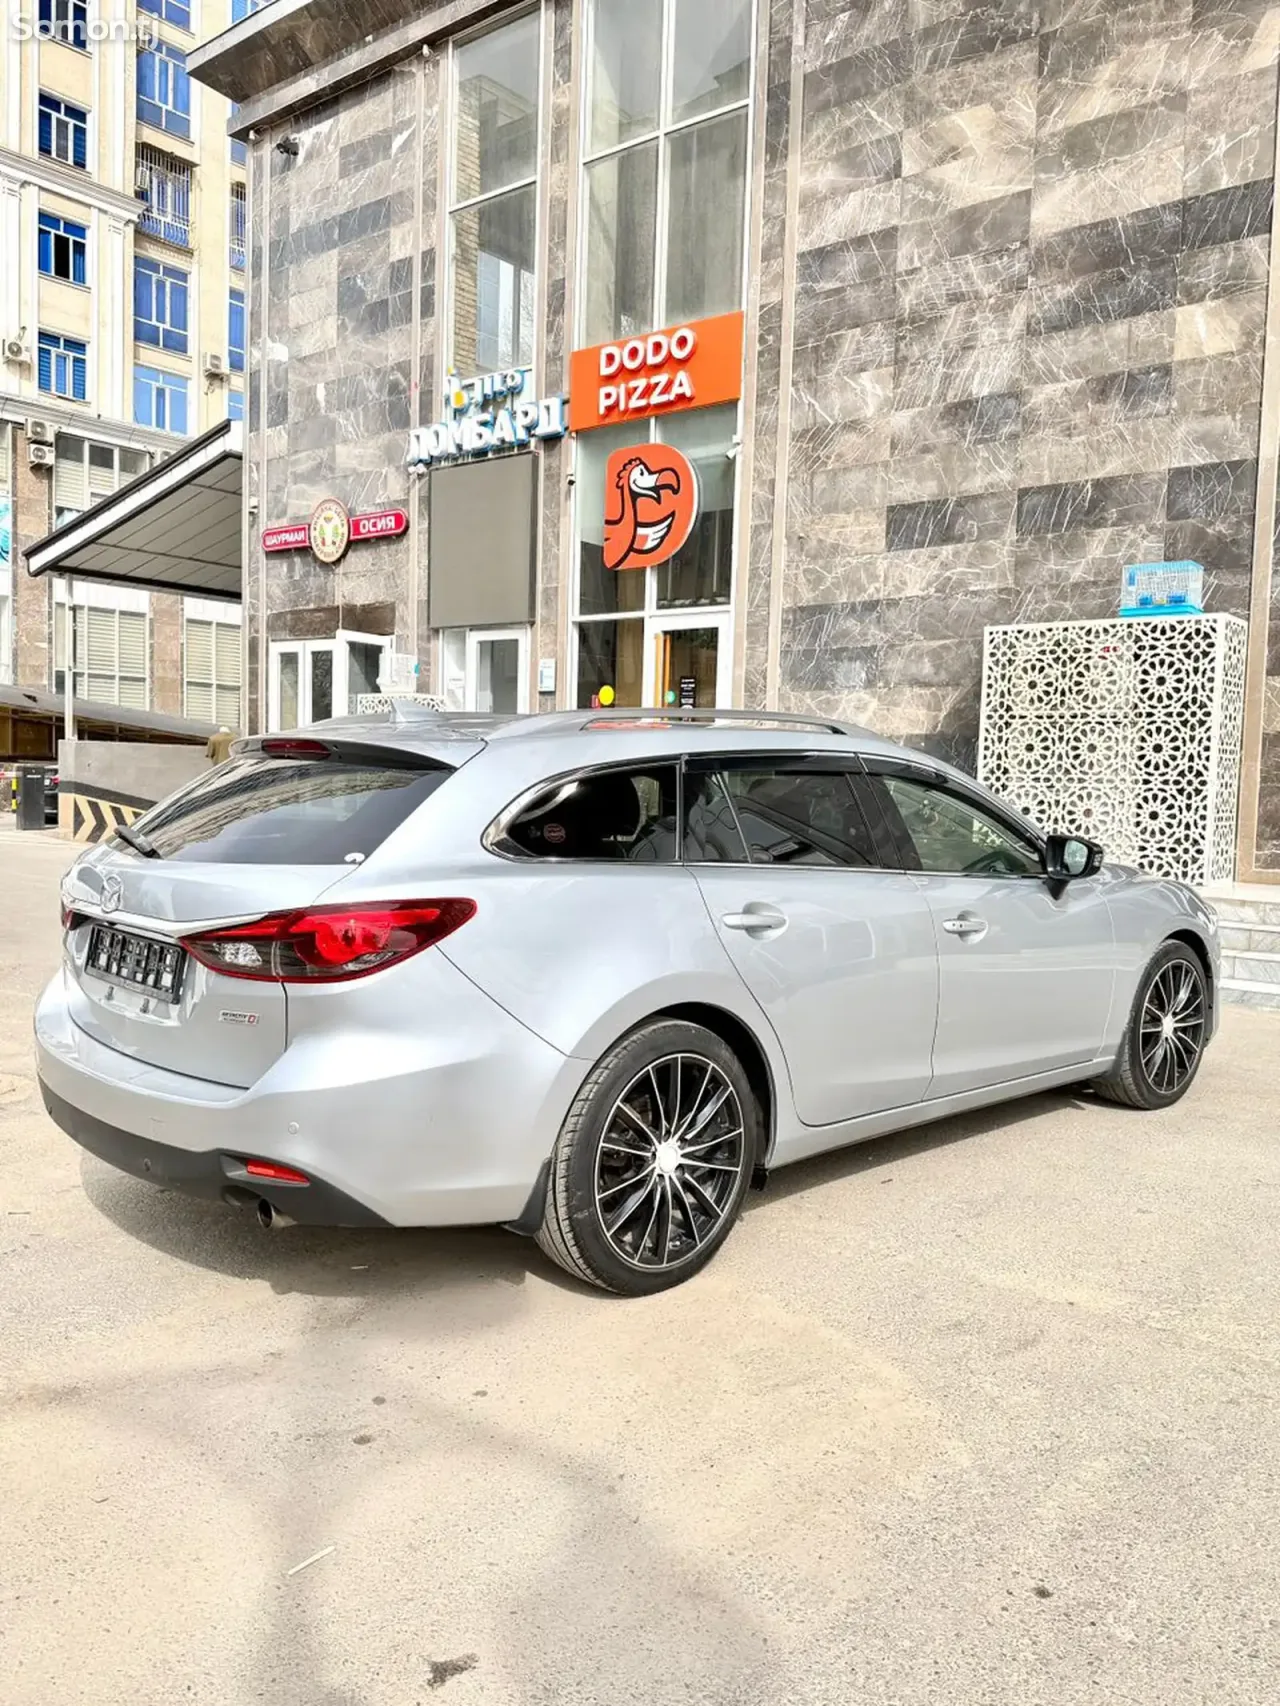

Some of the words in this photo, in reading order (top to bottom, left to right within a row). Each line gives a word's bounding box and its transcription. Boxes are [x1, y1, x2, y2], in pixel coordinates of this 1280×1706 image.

[600, 327, 696, 377] DODO
[598, 370, 693, 416] PIZZA
[407, 396, 565, 463] ЛОМБАРД
[359, 515, 396, 534] ОСИЯ
